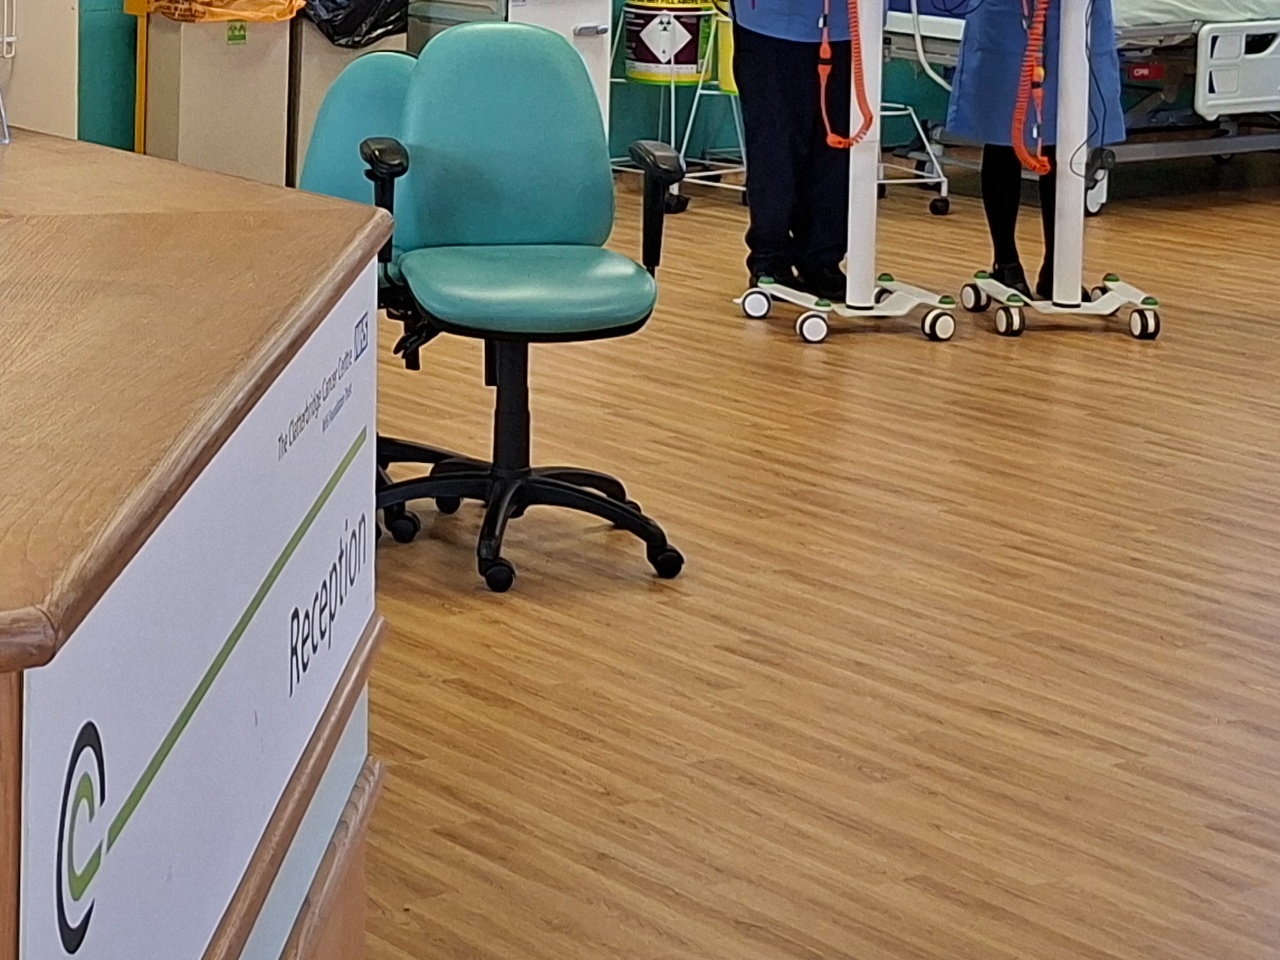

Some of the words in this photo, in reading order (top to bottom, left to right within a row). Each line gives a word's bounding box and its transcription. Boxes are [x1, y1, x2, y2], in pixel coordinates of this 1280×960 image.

[277, 432, 288, 461] The
[288, 390, 321, 447] Clatterbridge
[322, 368, 338, 402] Cancer
[338, 349, 353, 381] Centre
[354, 314, 369, 360] NHS
[288, 512, 366, 698] Reception
